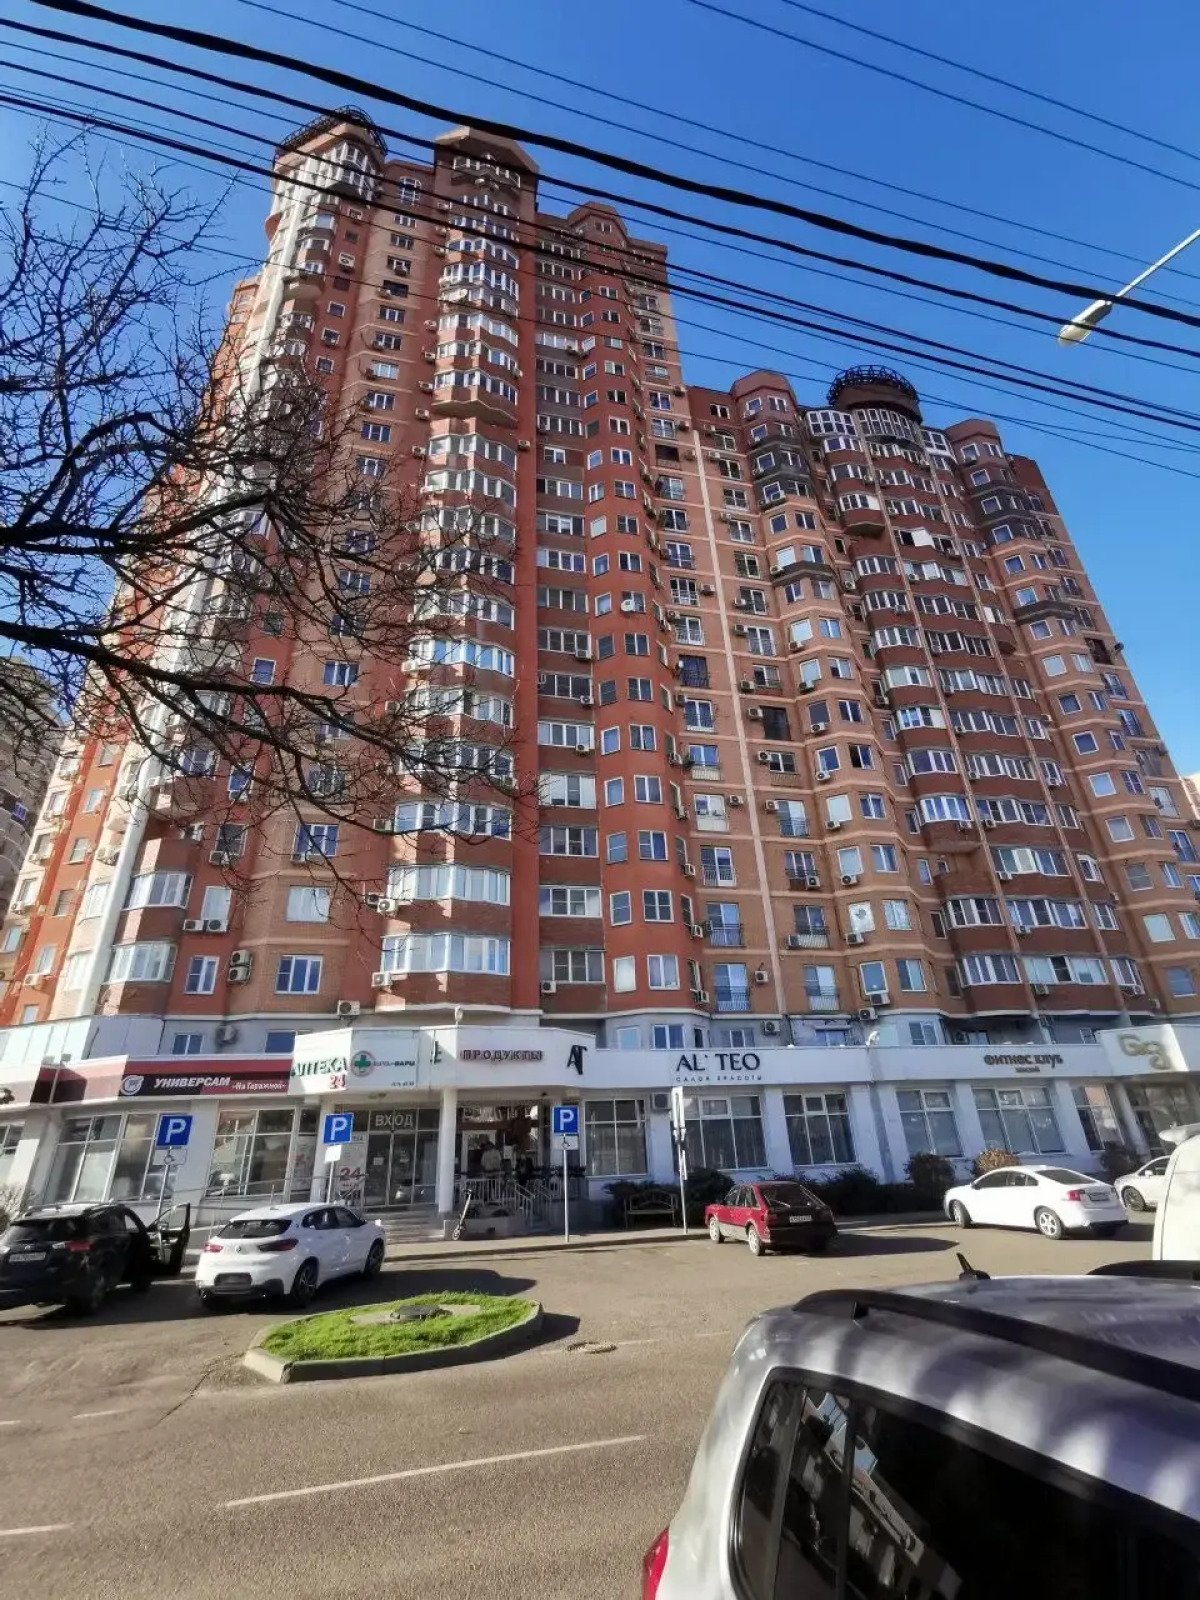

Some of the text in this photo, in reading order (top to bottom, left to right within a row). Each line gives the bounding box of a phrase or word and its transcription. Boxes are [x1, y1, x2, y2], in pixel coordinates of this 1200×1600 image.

[462, 1049, 543, 1061] ПРОДУКТЫ
[715, 1053, 761, 1071] TEO
[290, 1057, 347, 1077] АПТЕКА
[153, 1076, 231, 1088] УНИВЕРСАМ
[329, 1074, 346, 1089] 24
[375, 1114, 414, 1127] ВХОД
[560, 1109, 574, 1131] P
[165, 1118, 187, 1143] P
[330, 1117, 348, 1141] P
[339, 1166, 361, 1181] 24
